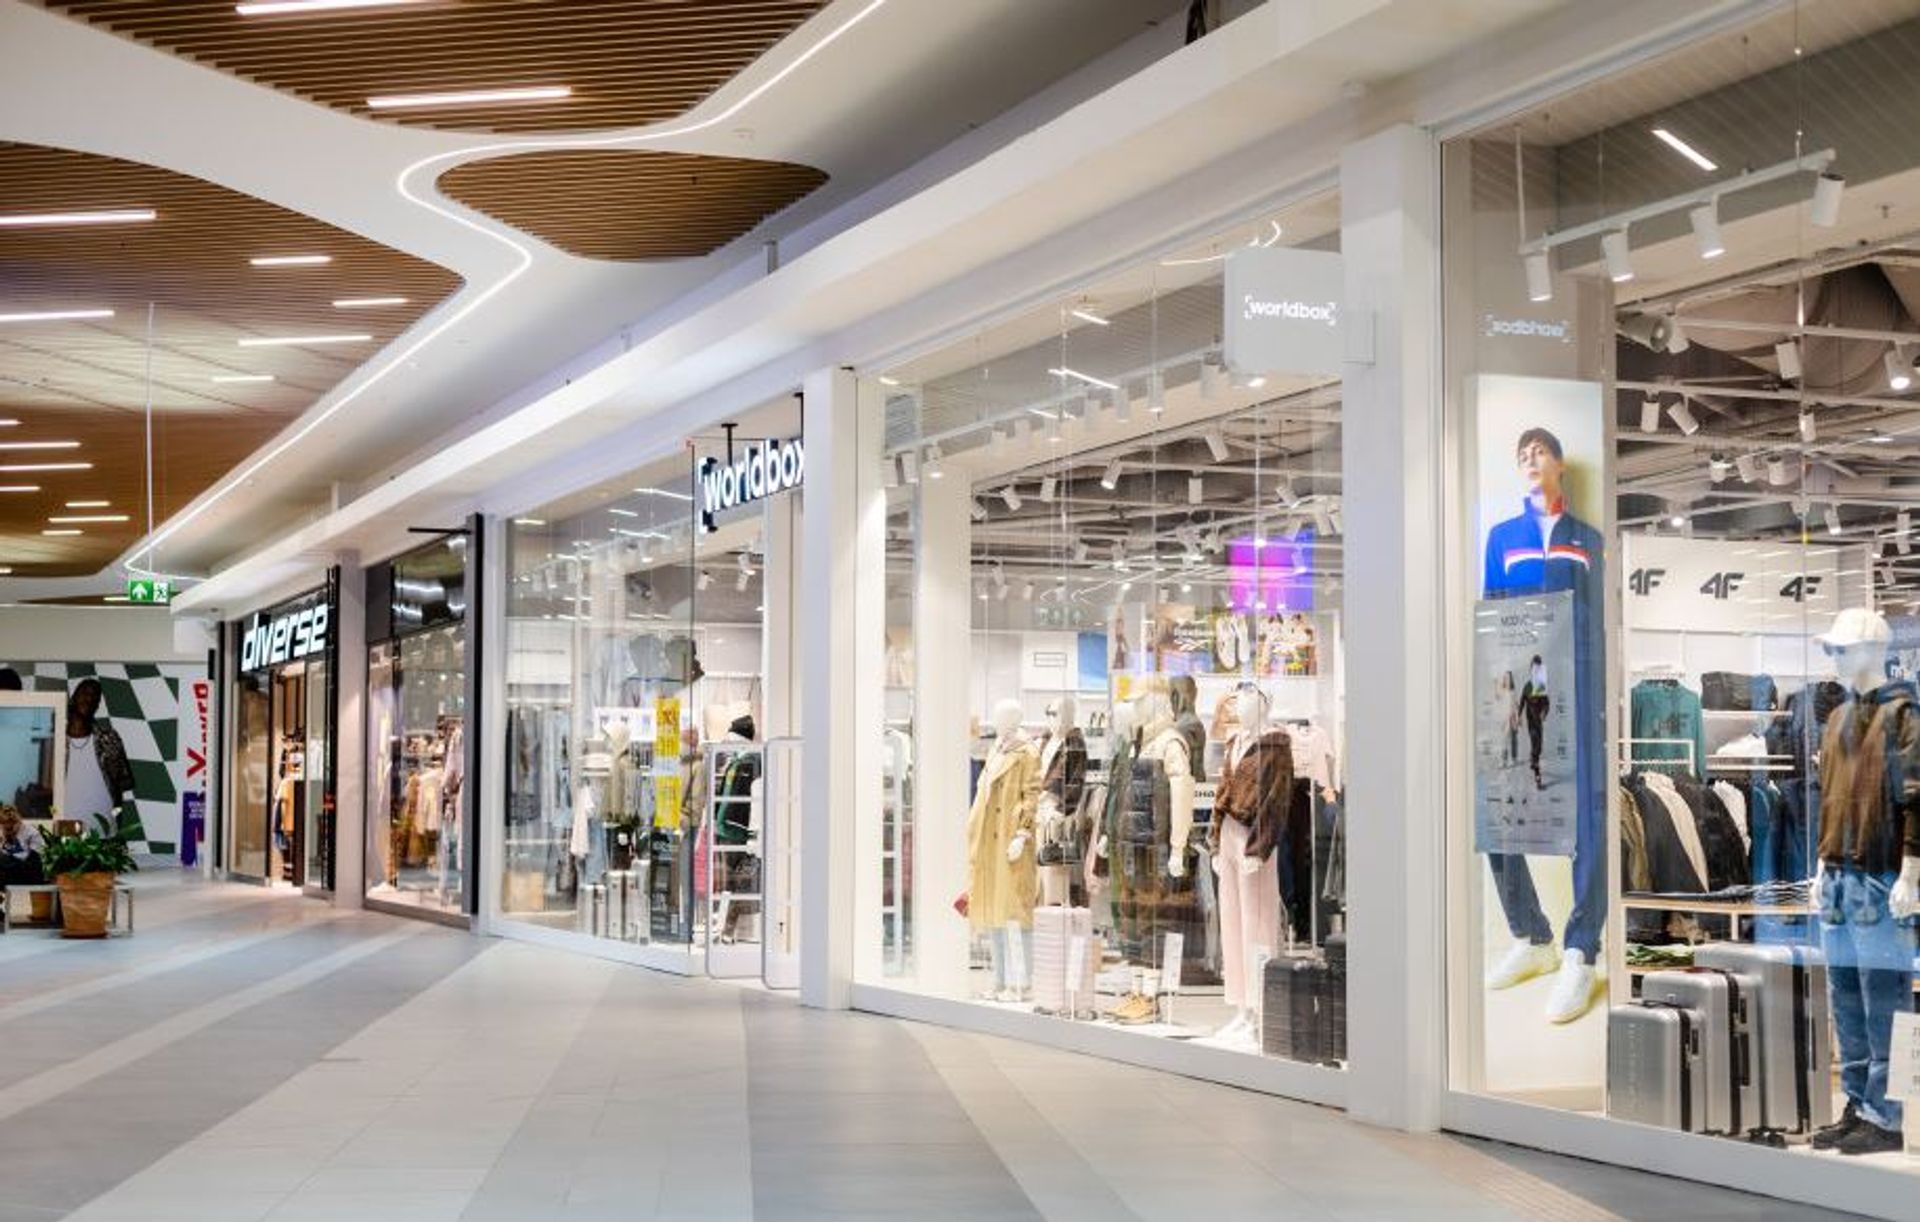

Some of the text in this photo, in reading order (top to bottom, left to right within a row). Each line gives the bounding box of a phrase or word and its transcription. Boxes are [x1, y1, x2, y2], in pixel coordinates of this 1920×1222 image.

[1700, 572, 1745, 599] 4F
[1779, 576, 1822, 602] 4F
[241, 603, 328, 672] diverse
